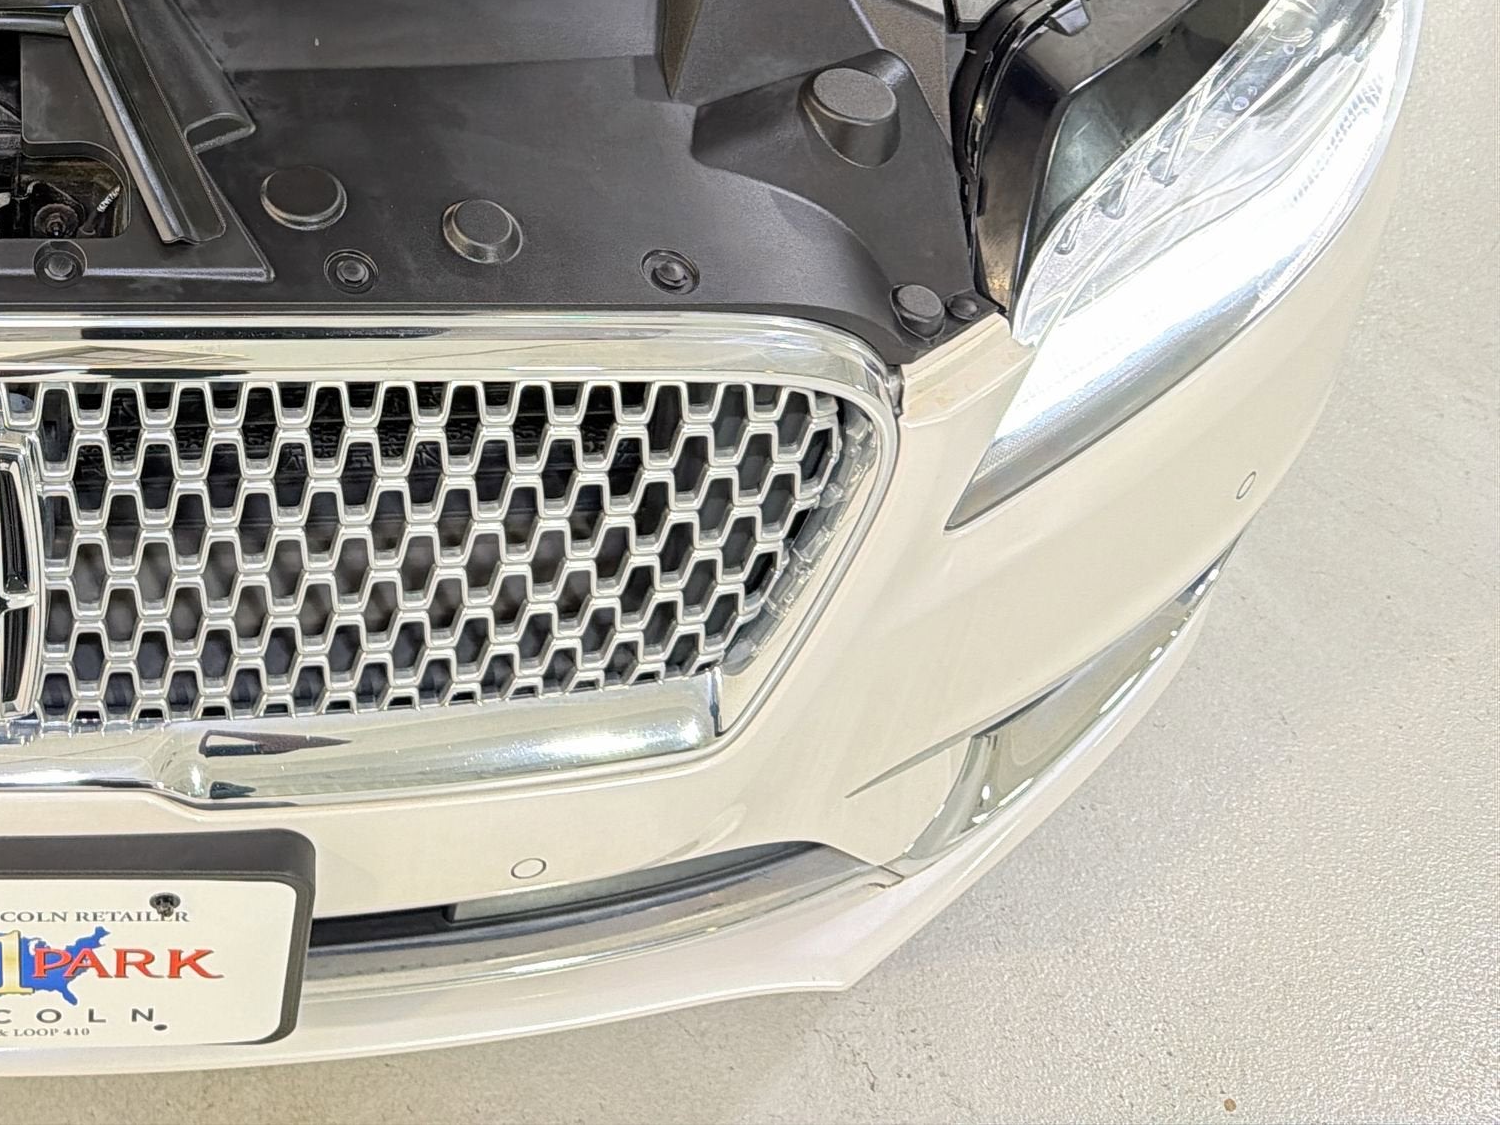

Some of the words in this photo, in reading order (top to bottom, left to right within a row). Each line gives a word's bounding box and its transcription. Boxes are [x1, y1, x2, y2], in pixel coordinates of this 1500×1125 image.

[32, 948, 225, 979] PARK
[14, 1028, 59, 1037] LOOP
[63, 1028, 90, 1036] 410
